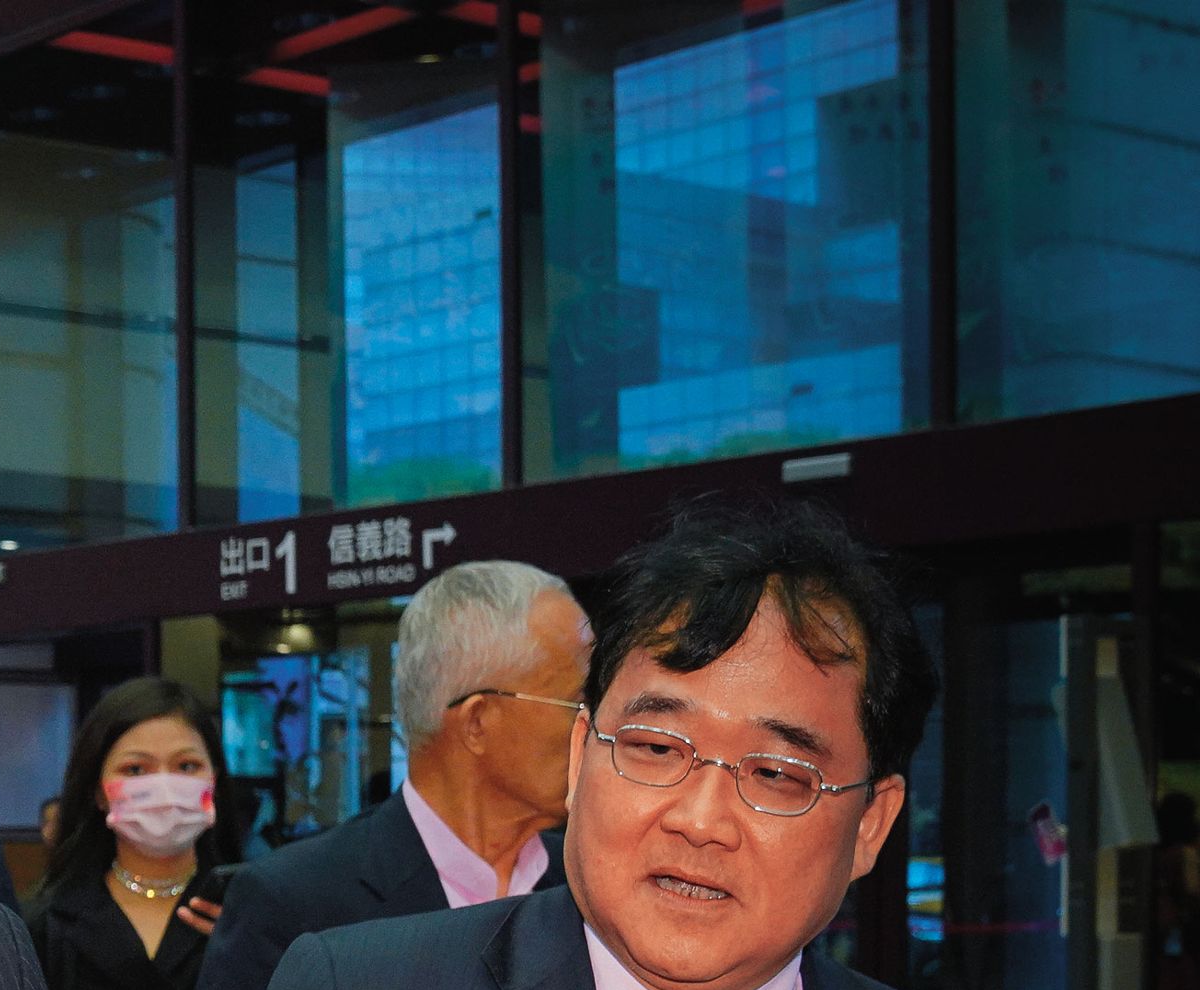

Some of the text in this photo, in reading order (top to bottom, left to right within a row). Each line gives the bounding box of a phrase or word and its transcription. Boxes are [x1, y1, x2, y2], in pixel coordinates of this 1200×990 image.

[220, 530, 296, 594] 出口 1
[328, 516, 412, 565] 信義路
